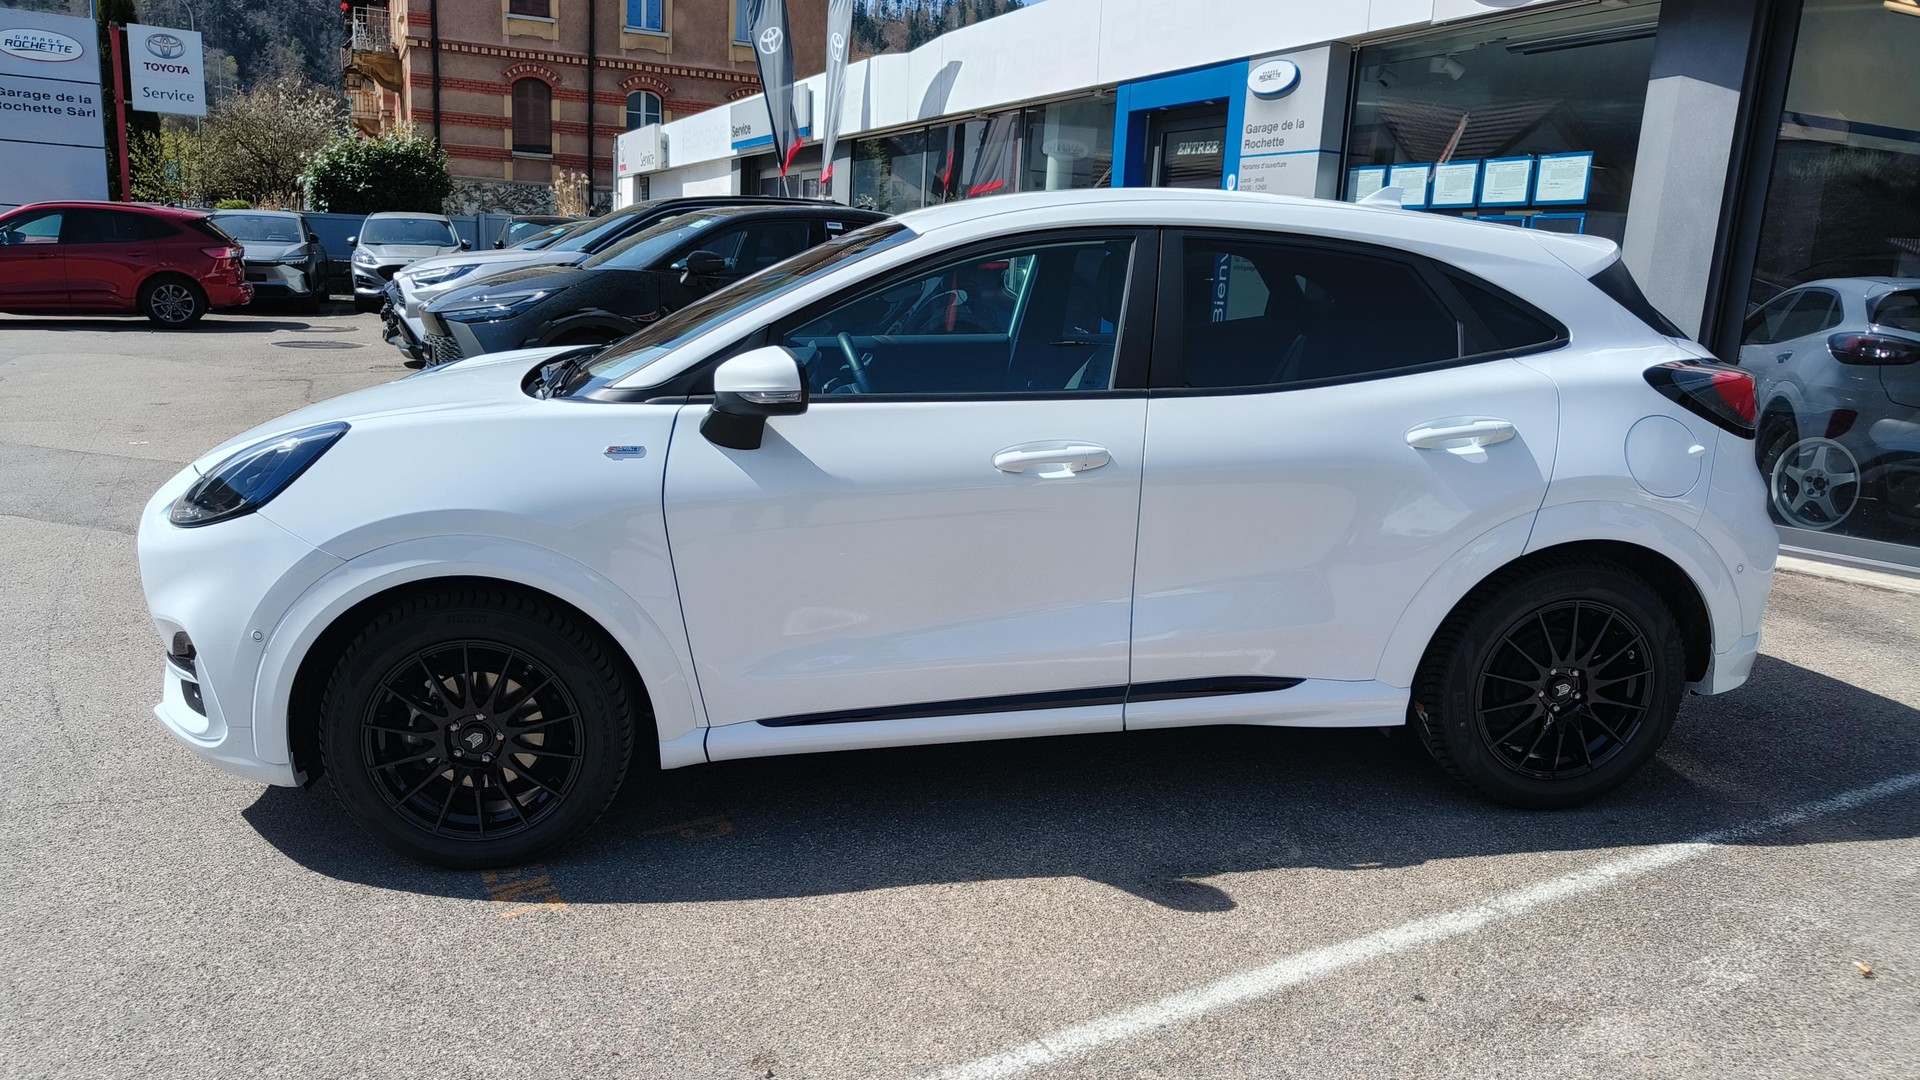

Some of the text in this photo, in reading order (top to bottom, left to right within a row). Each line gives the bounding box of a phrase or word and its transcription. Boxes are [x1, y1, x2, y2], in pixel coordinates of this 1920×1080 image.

[4, 38, 73, 54] ROCHETTE
[14, 34, 62, 44] GARAGE
[143, 62, 190, 75] TOYOTA
[0, 86, 92, 105] Garage de la
[142, 86, 195, 102] Service
[731, 123, 752, 138] Service
[1245, 118, 1305, 135] Garage de la
[1177, 140, 1220, 155] ENTREE
[1244, 137, 1285, 150] Rochette
[640, 150, 655, 167] Service
